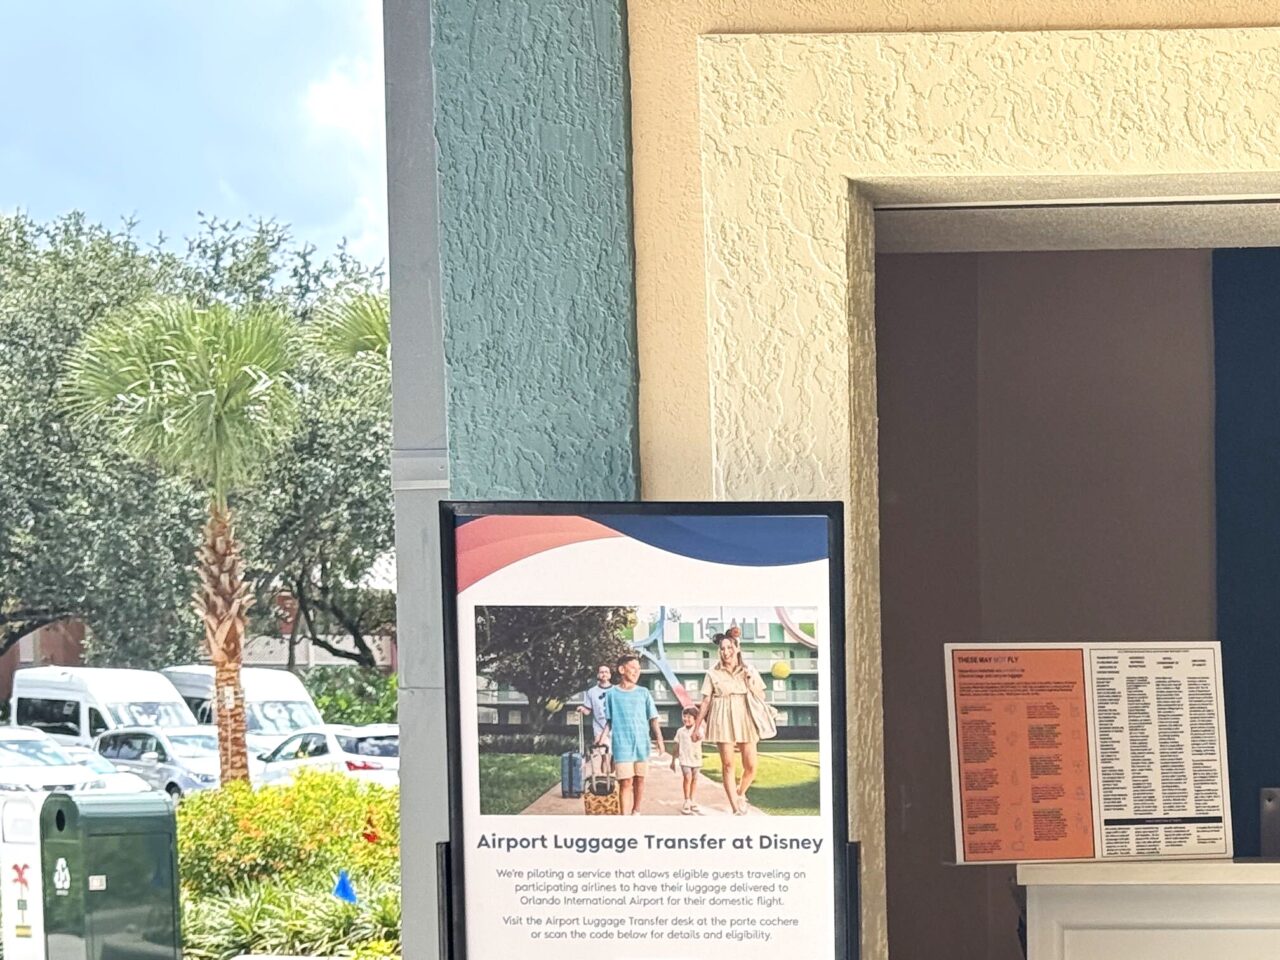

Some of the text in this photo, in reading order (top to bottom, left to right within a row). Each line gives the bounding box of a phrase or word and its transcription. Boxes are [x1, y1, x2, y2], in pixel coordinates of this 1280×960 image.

[476, 832, 824, 855] Airport Luggage Transfer at Disney
[495, 868, 807, 882] We're piloting a service that allows eligible guests traveling on
[514, 881, 789, 895] participating airlines to have their luggage delivered to
[519, 895, 562, 906] Orlando
[563, 895, 627, 906] International
[628, 895, 665, 908] Airport
[666, 895, 681, 906] for
[683, 896, 706, 906] their
[708, 896, 754, 906] domestic
[502, 915, 523, 926] Visit
[525, 915, 543, 926] the
[545, 915, 580, 928] Airport
[582, 916, 627, 929] Luggage
[628, 915, 669, 926] Transfer
[670, 916, 695, 927] desk
[696, 917, 708, 927] at
[710, 916, 727, 927] the
[759, 916, 799, 927] cochere
[530, 929, 772, 942] or scan the code below for details and eligibility.
